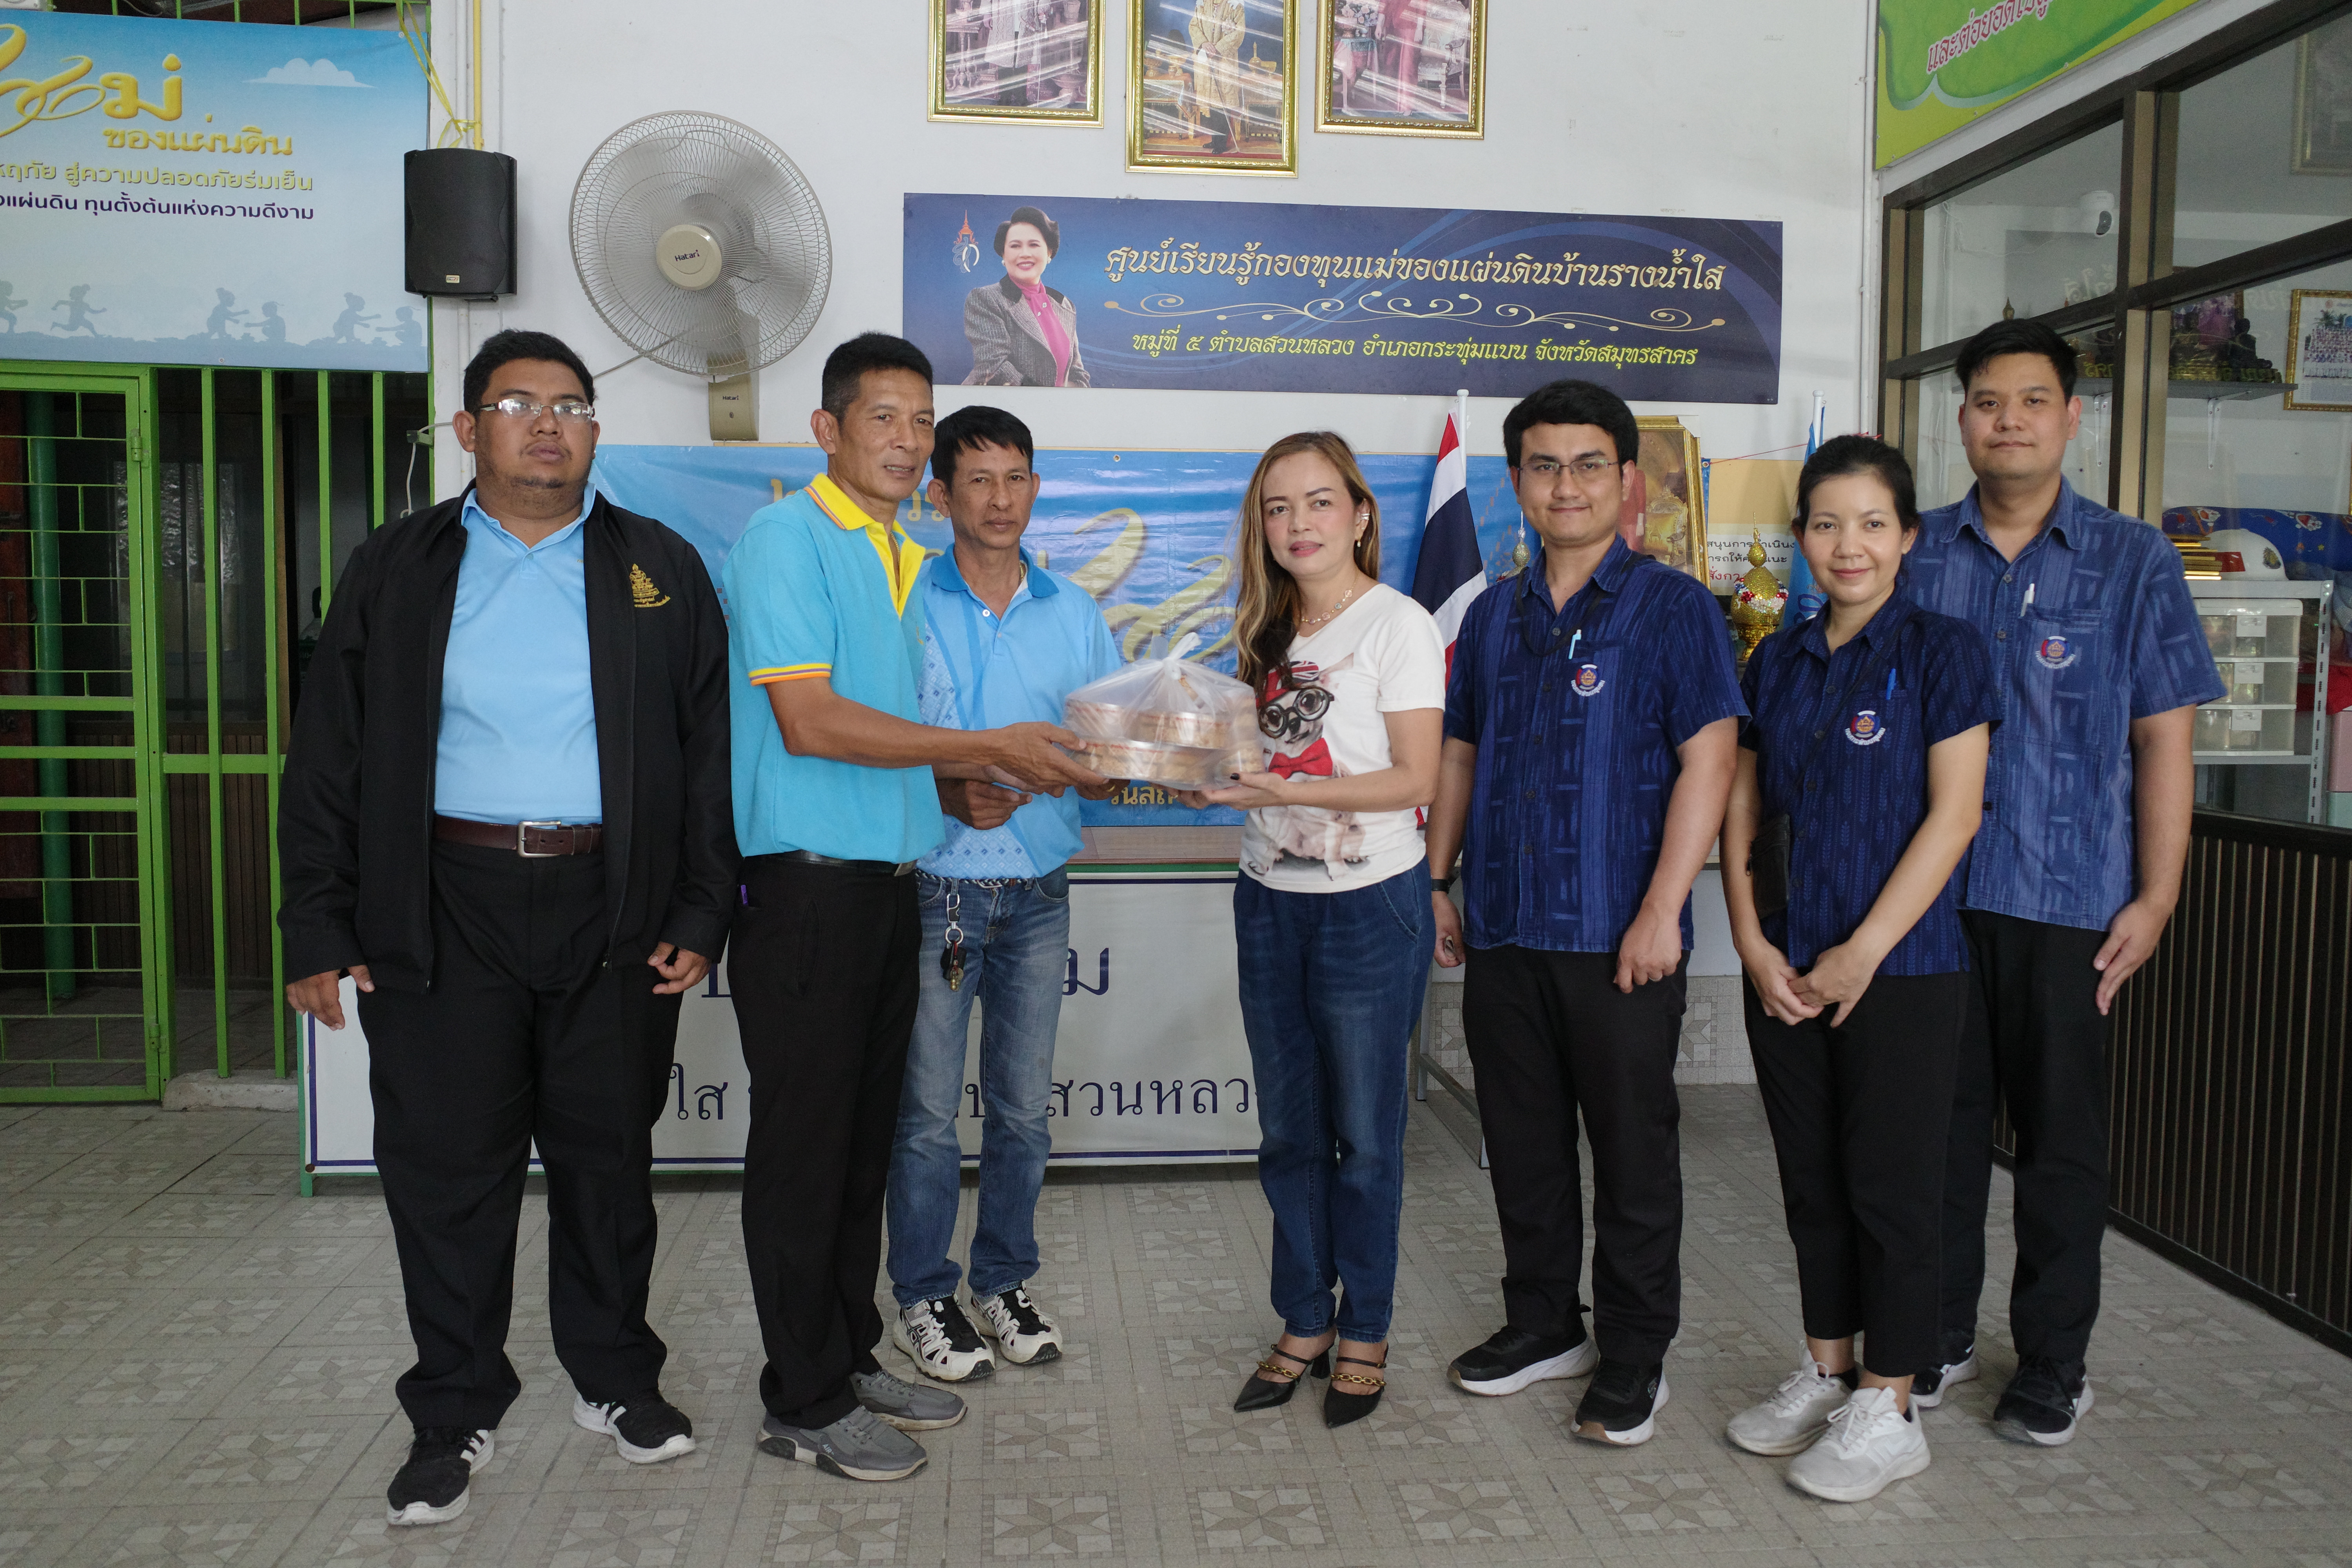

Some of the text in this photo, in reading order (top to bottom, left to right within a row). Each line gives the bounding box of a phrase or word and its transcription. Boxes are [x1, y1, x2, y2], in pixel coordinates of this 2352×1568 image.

[103, 113, 293, 156] ของแผ่นดิน
[65, 161, 312, 191] สู่ความปลอดภัยร่มเย็น
[85, 192, 314, 219] ทุนตั้งต้นแห่งความดีงาม
[674, 249, 700, 261] Hatari
[1103, 237, 1727, 290] ศูนย์เรียนรู้กองทุนแม่ของแผ่นดินบ้านรางน้ำใส
[1132, 324, 1181, 358] หมู่ที่
[1209, 329, 1356, 356] ตำบลสวนหลวง
[1363, 333, 1528, 366] อำเภอกระทุ่มแบน
[1535, 338, 1699, 370] จังหวัดสมุทรสาคร
[1045, 1078, 1258, 1117] สวนหลว
